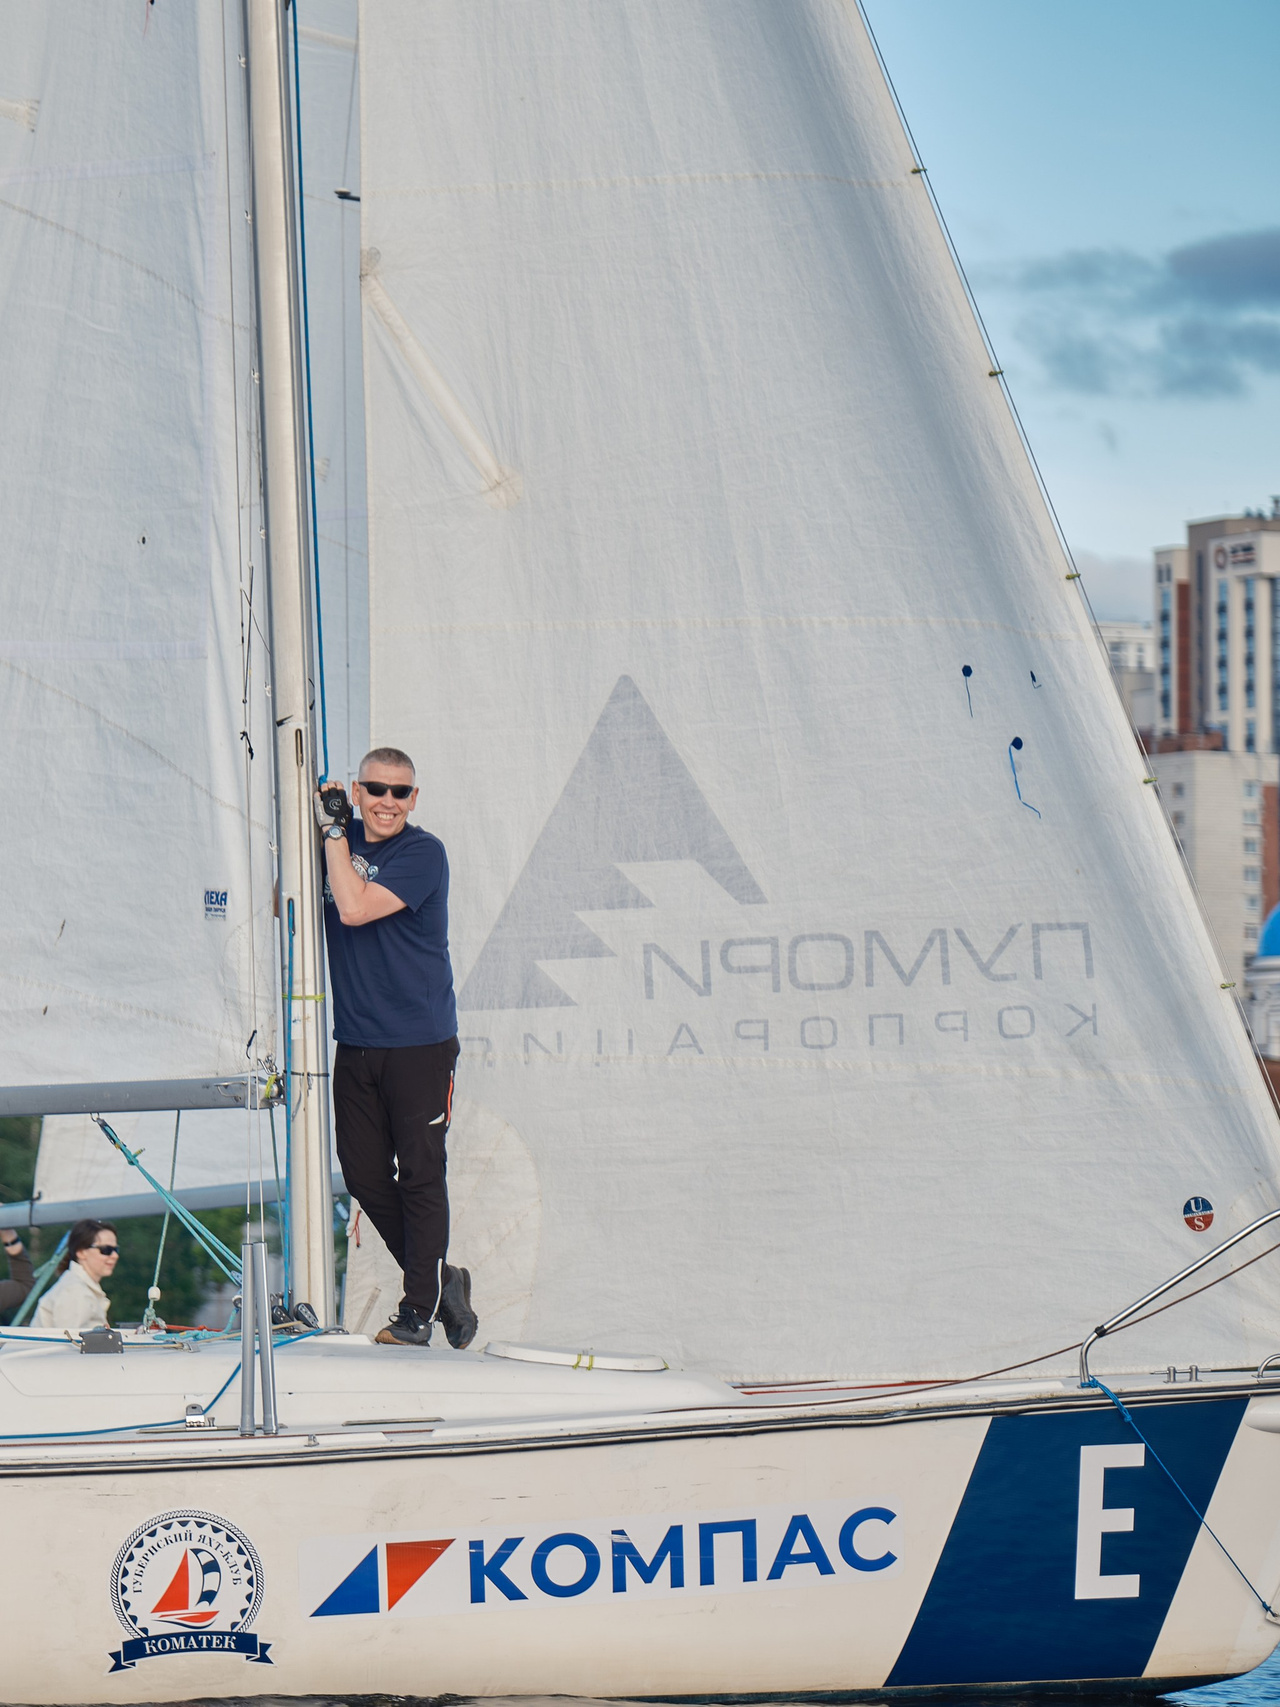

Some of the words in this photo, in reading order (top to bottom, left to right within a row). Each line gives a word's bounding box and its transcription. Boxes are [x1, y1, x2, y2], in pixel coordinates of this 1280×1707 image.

[133, 1529, 194, 1594] ГУБЕРНСКИЙ
[197, 1533, 242, 1586] ЯХТ-КЛУБ
[470, 1506, 898, 1604] КОМПАС
[1074, 1443, 1146, 1600] E
[143, 1634, 237, 1655] КОМАТЕК
